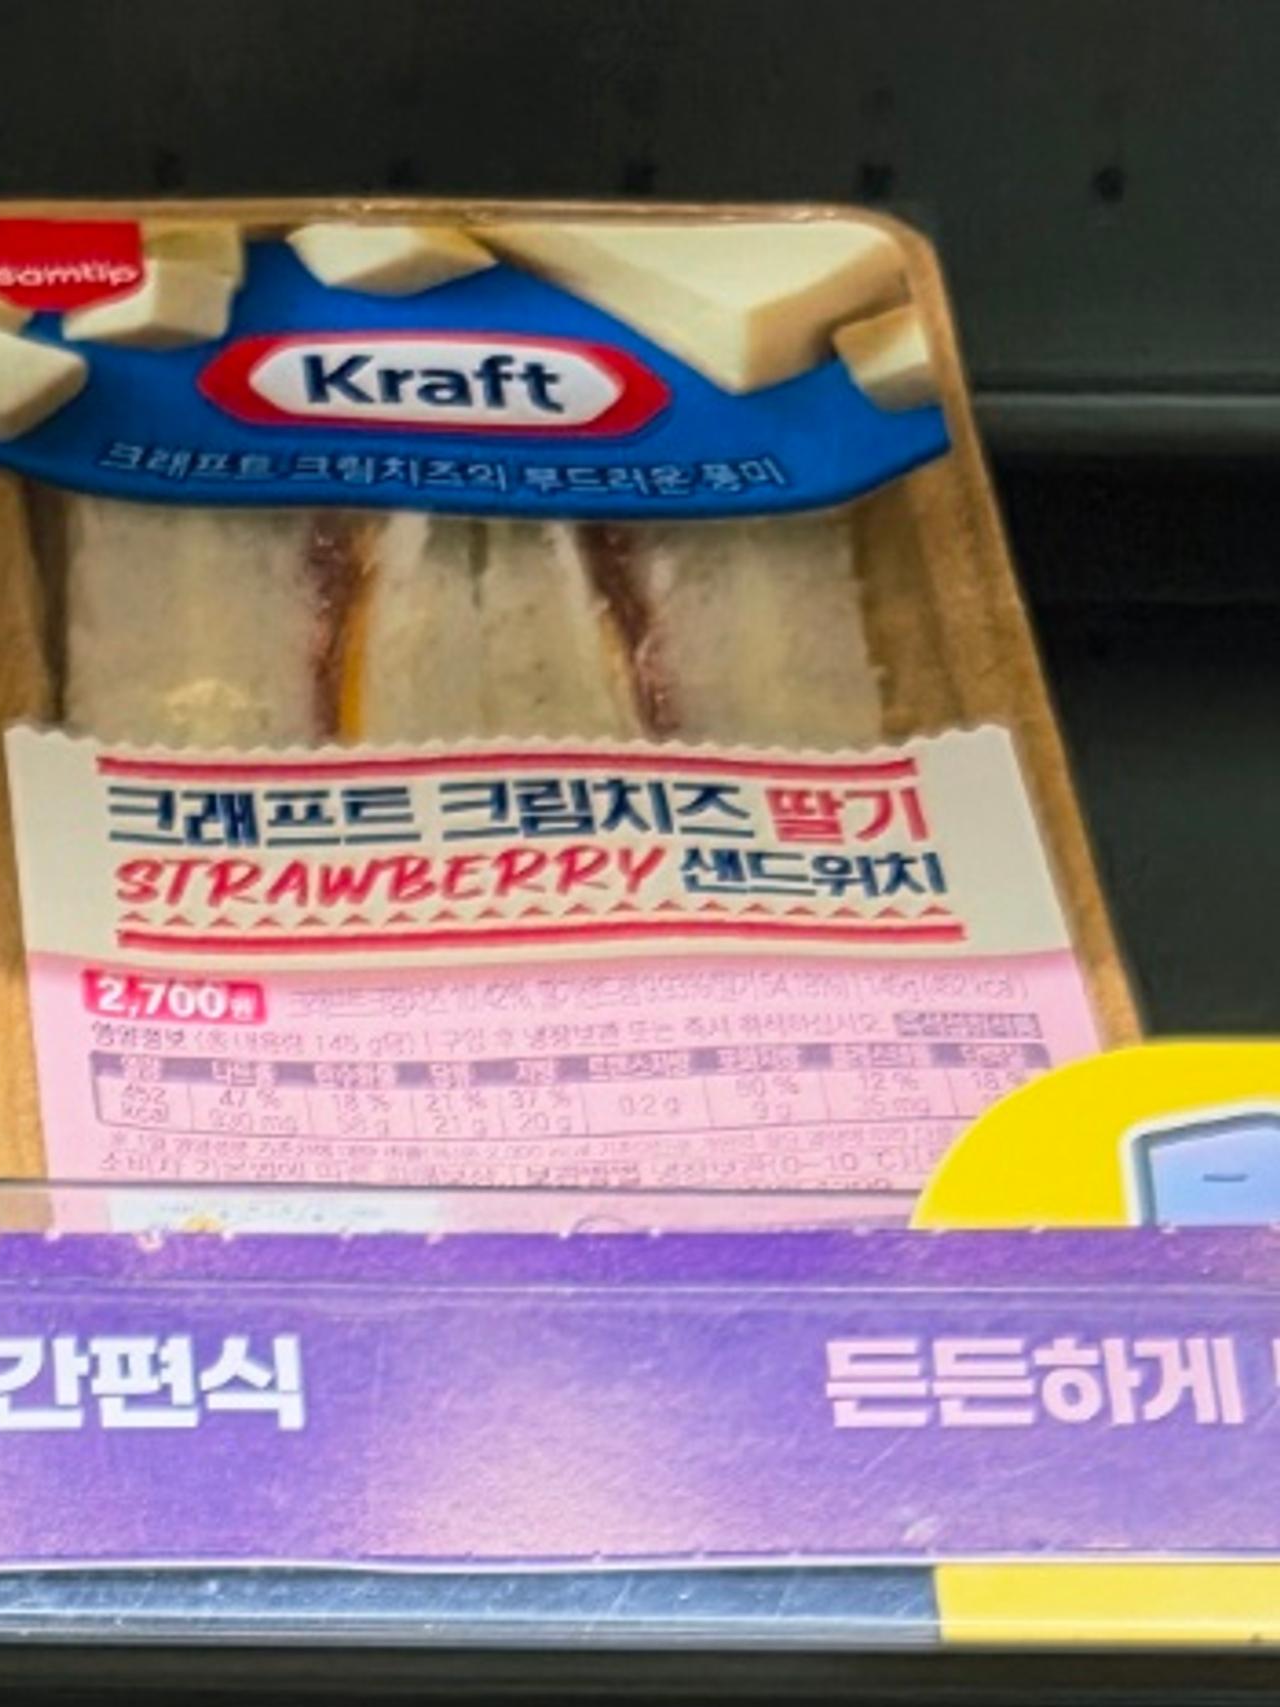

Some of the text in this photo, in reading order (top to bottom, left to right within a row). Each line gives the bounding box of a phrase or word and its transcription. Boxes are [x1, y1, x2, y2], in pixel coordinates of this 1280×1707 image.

[305, 353, 564, 414] Kraft
[108, 776, 931, 848] 크래프트 크림치즈 딸기
[115, 845, 946, 910] STRAWBERRY 샌드위치
[825, 1336, 1246, 1428] 든든하게
